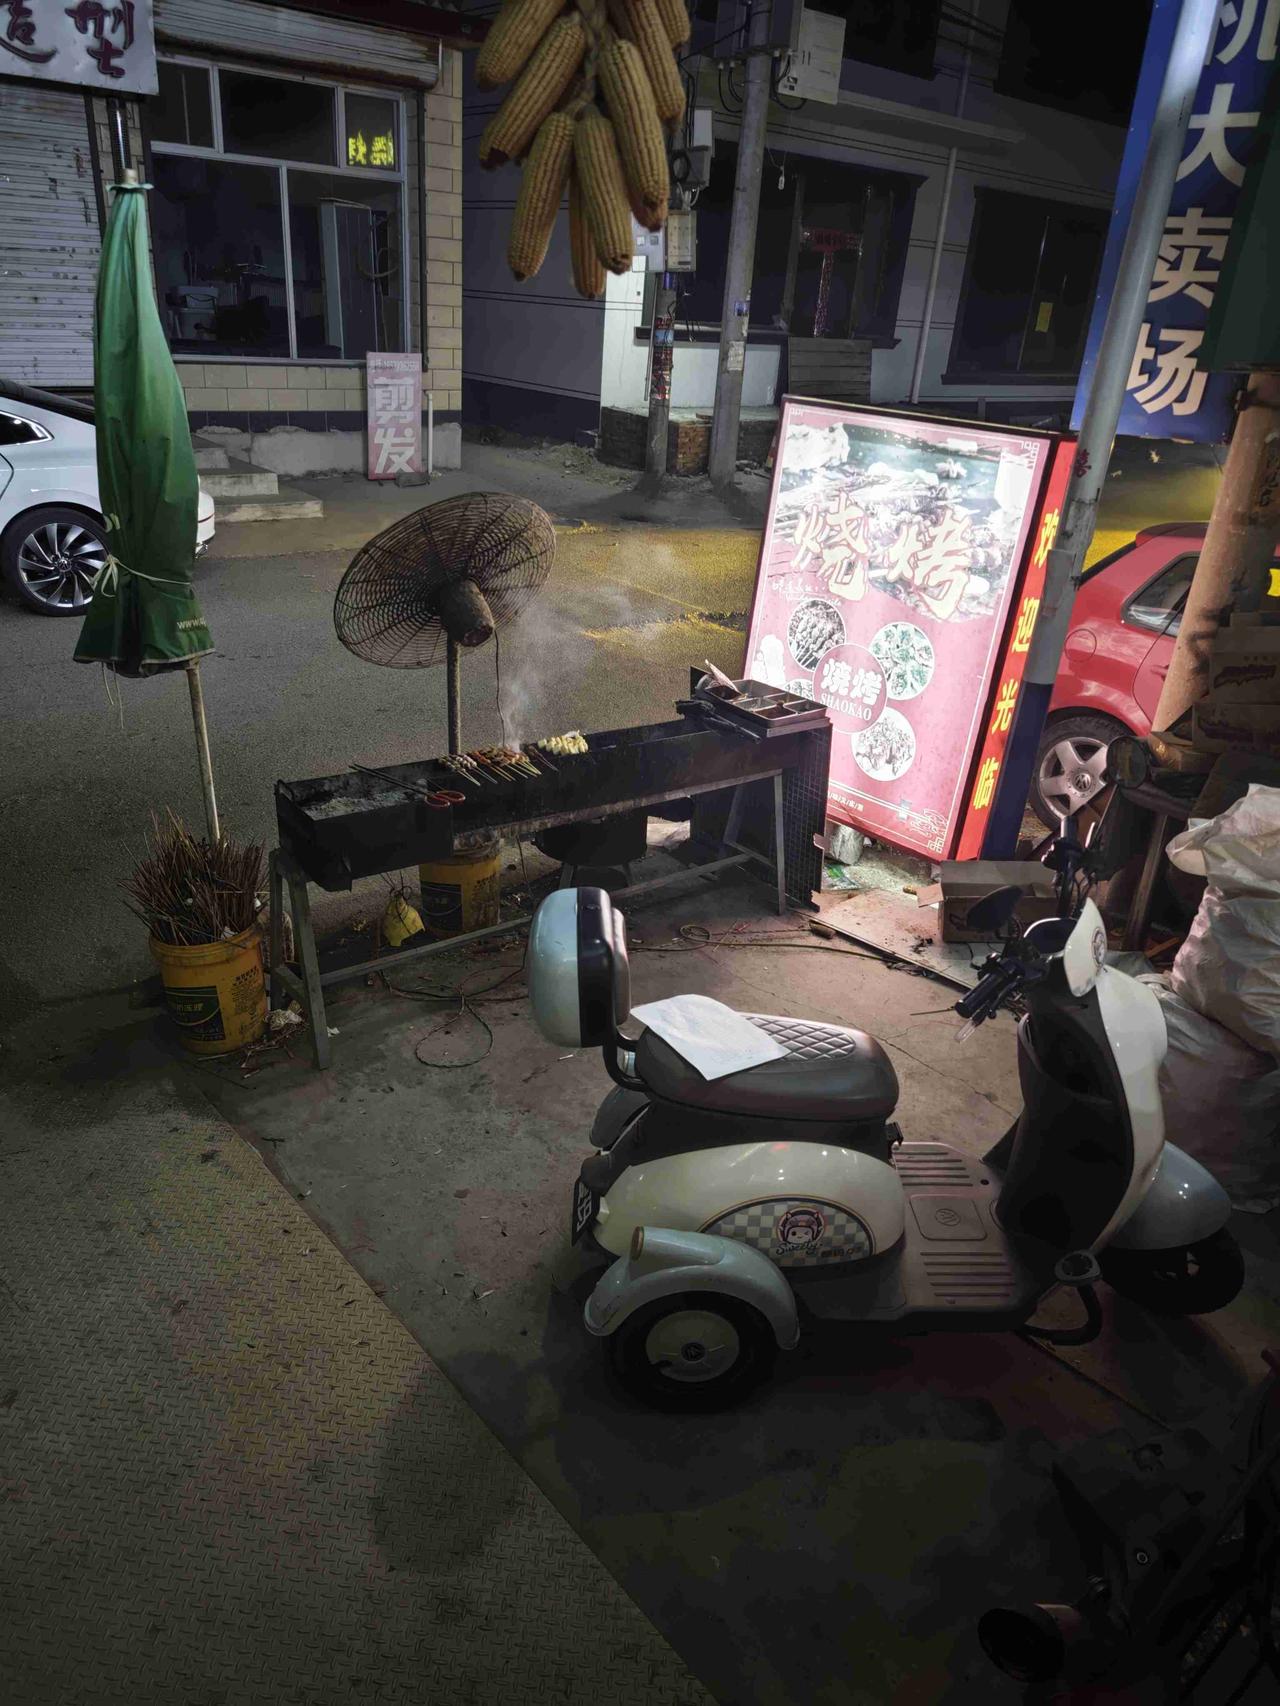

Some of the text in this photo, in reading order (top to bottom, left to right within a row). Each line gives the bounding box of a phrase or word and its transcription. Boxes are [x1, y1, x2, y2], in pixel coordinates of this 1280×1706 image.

[374, 377, 416, 474] 剪发
[790, 488, 971, 620] 烧烤
[820, 658, 882, 706] 烧烤
[821, 693, 872, 721] SHAOKAO
